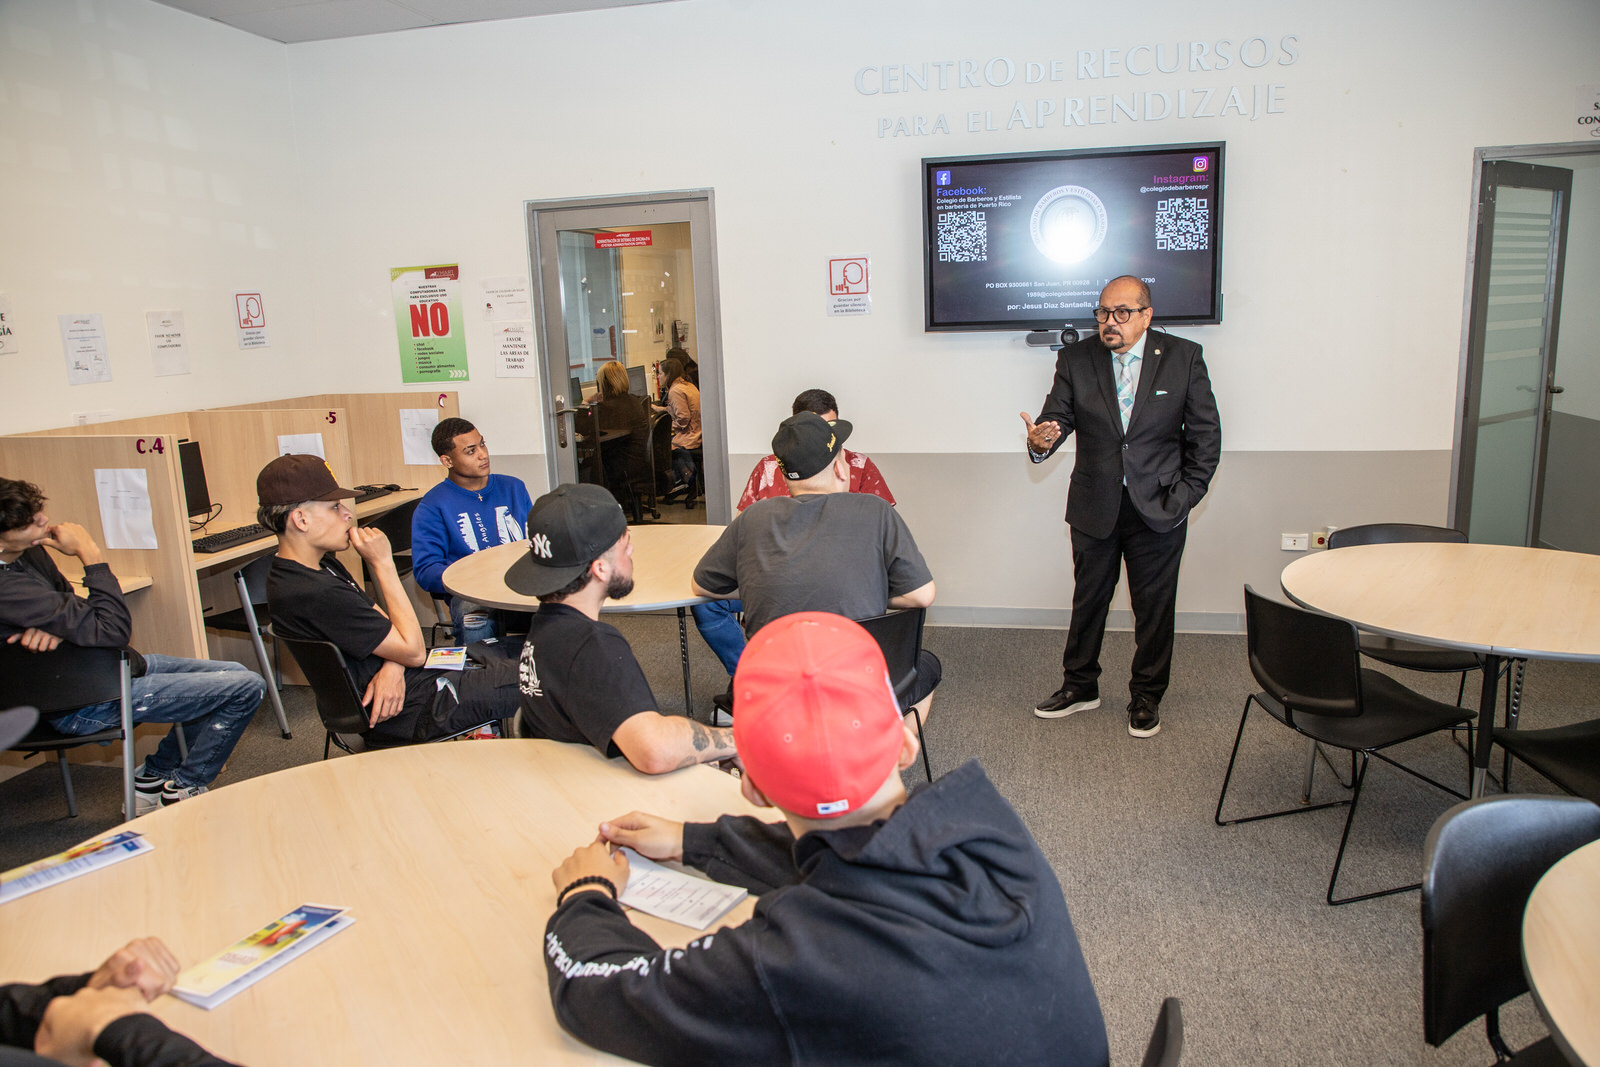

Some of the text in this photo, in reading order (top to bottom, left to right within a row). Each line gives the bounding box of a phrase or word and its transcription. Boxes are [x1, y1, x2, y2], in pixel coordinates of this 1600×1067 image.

[855, 33, 1300, 95] CENTRO DE RECURSOS
[878, 84, 1286, 138] PARA EL APRENDIZAJE
[1594, 102, 1600, 110] S
[936, 186, 987, 197] Facebook:
[1140, 184, 1209, 193] @colegiodebarberospr
[1153, 174, 1209, 184] Instagram:
[410, 302, 450, 337] NO
[474, 512, 489, 542] Angeles
[532, 532, 553, 558] NY
